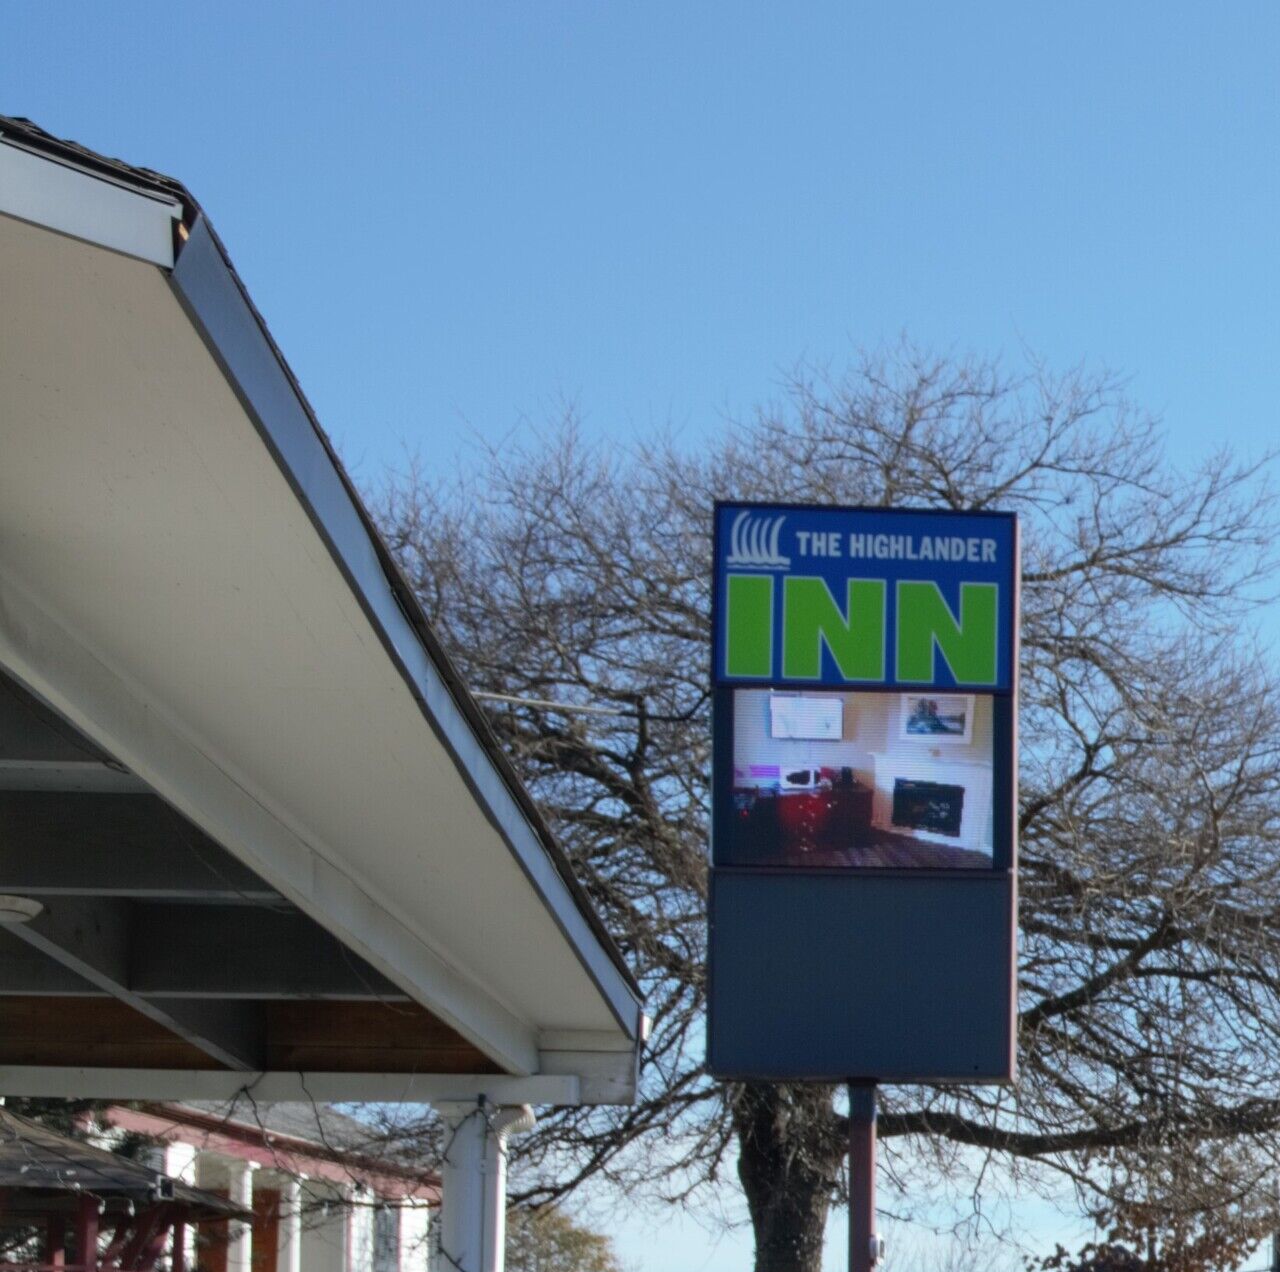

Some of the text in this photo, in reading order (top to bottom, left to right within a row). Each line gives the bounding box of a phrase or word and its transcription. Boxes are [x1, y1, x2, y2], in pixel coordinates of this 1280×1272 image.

[796, 531, 997, 563] THE HIGHLANDER
[725, 573, 999, 685] INN
